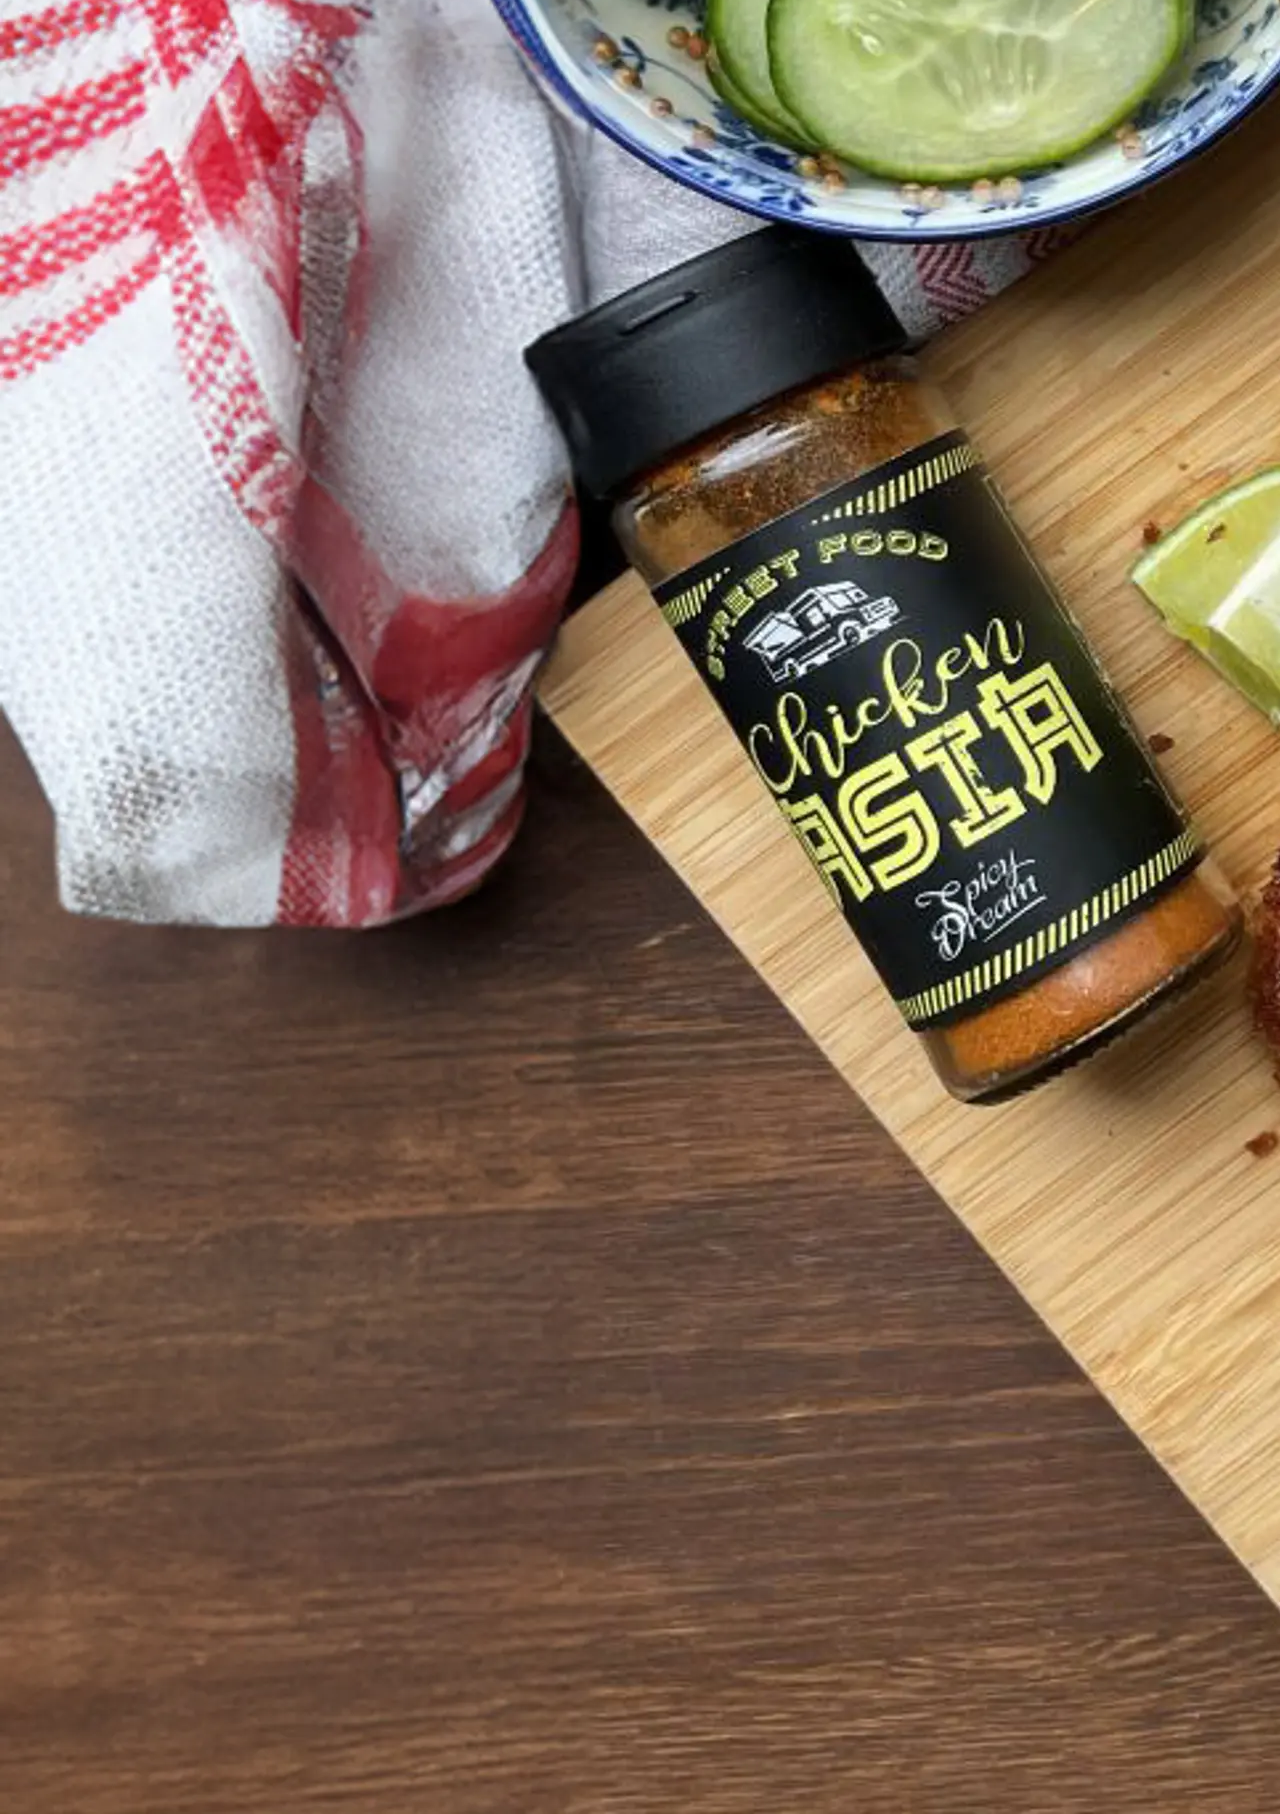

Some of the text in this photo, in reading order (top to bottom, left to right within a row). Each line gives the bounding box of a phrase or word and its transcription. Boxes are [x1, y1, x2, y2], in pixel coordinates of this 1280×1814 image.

[706, 528, 949, 682] STREET FOOD
[747, 617, 1025, 795] Chicken
[777, 662, 1103, 902] ASIA
[915, 847, 1036, 920] Spicy
[931, 874, 1040, 962] Dream
